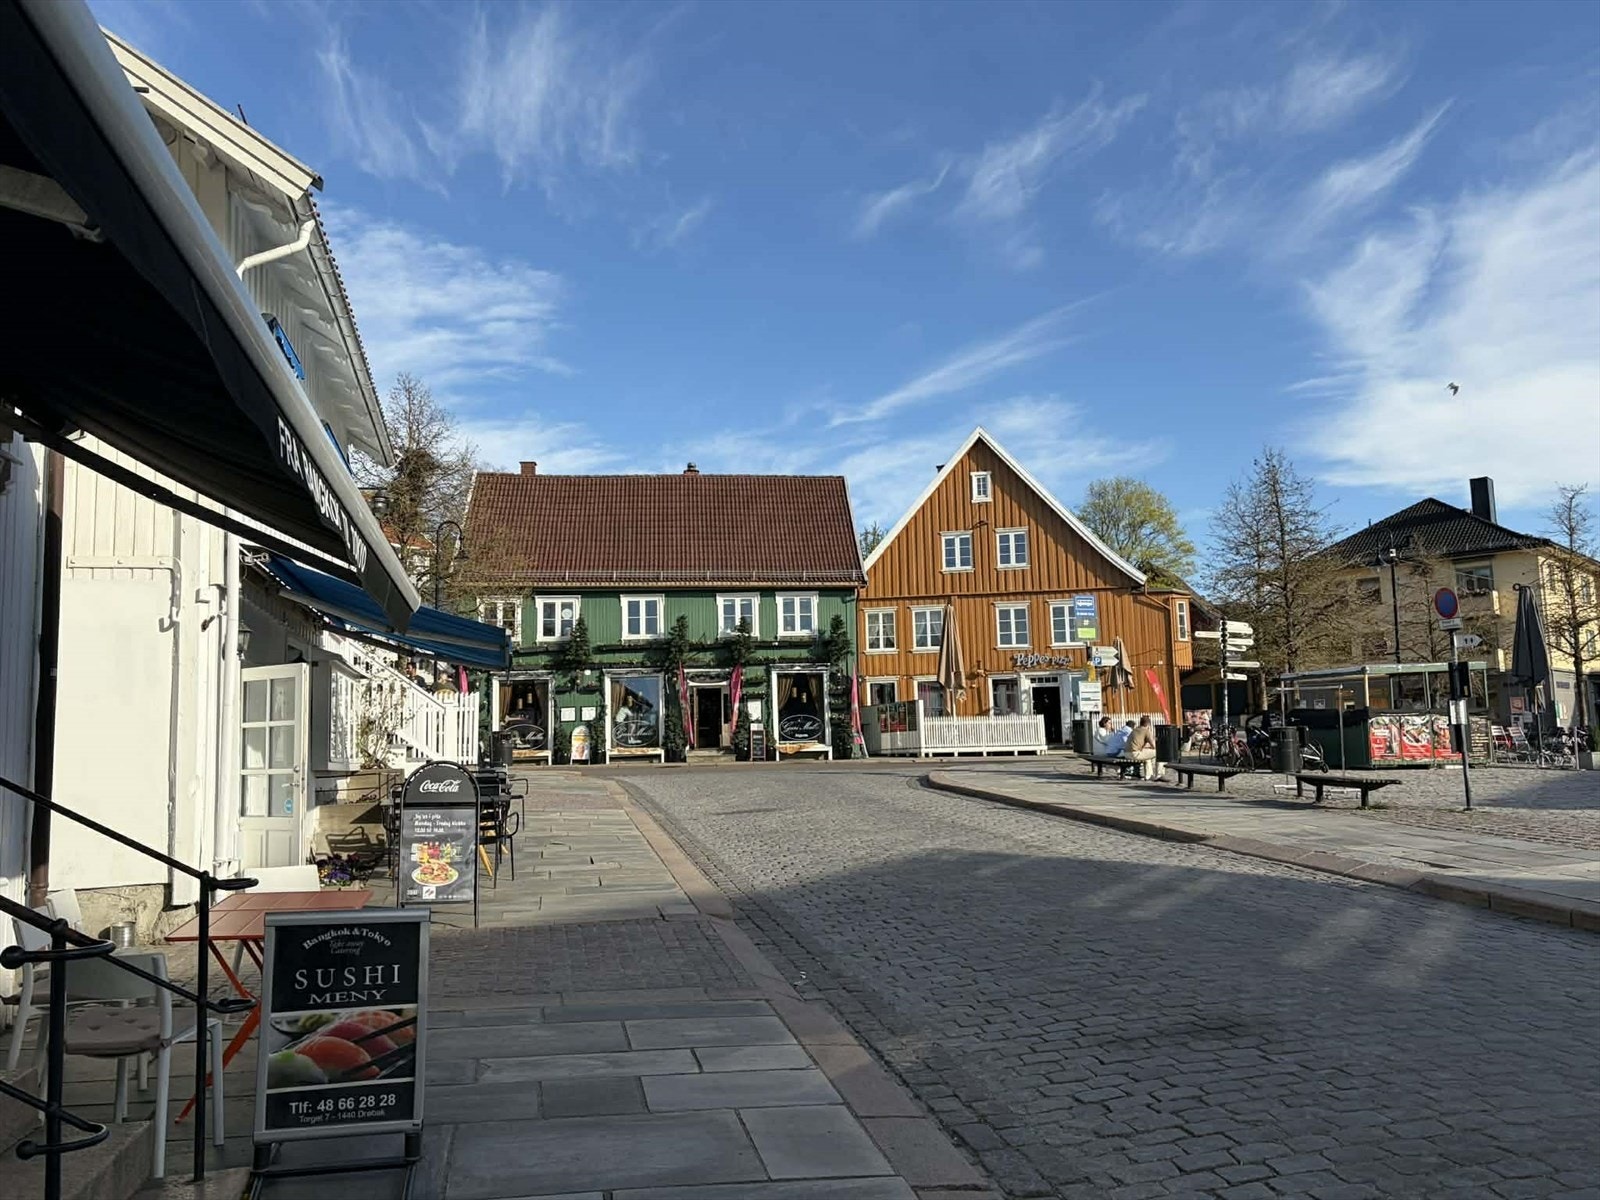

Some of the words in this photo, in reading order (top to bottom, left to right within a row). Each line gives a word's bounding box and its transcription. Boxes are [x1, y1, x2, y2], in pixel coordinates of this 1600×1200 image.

[277, 415, 305, 480] FRA
[302, 927, 351, 950] Bangkok
[361, 927, 391, 947] Tokyo
[294, 964, 401, 990] SUSHI
[308, 989, 388, 1005] MENY
[289, 1101, 313, 1115] Tlf:
[316, 1099, 334, 1112] 48
[338, 1097, 355, 1110] 66
[358, 1095, 376, 1108] 28
[379, 1093, 396, 1106] 28
